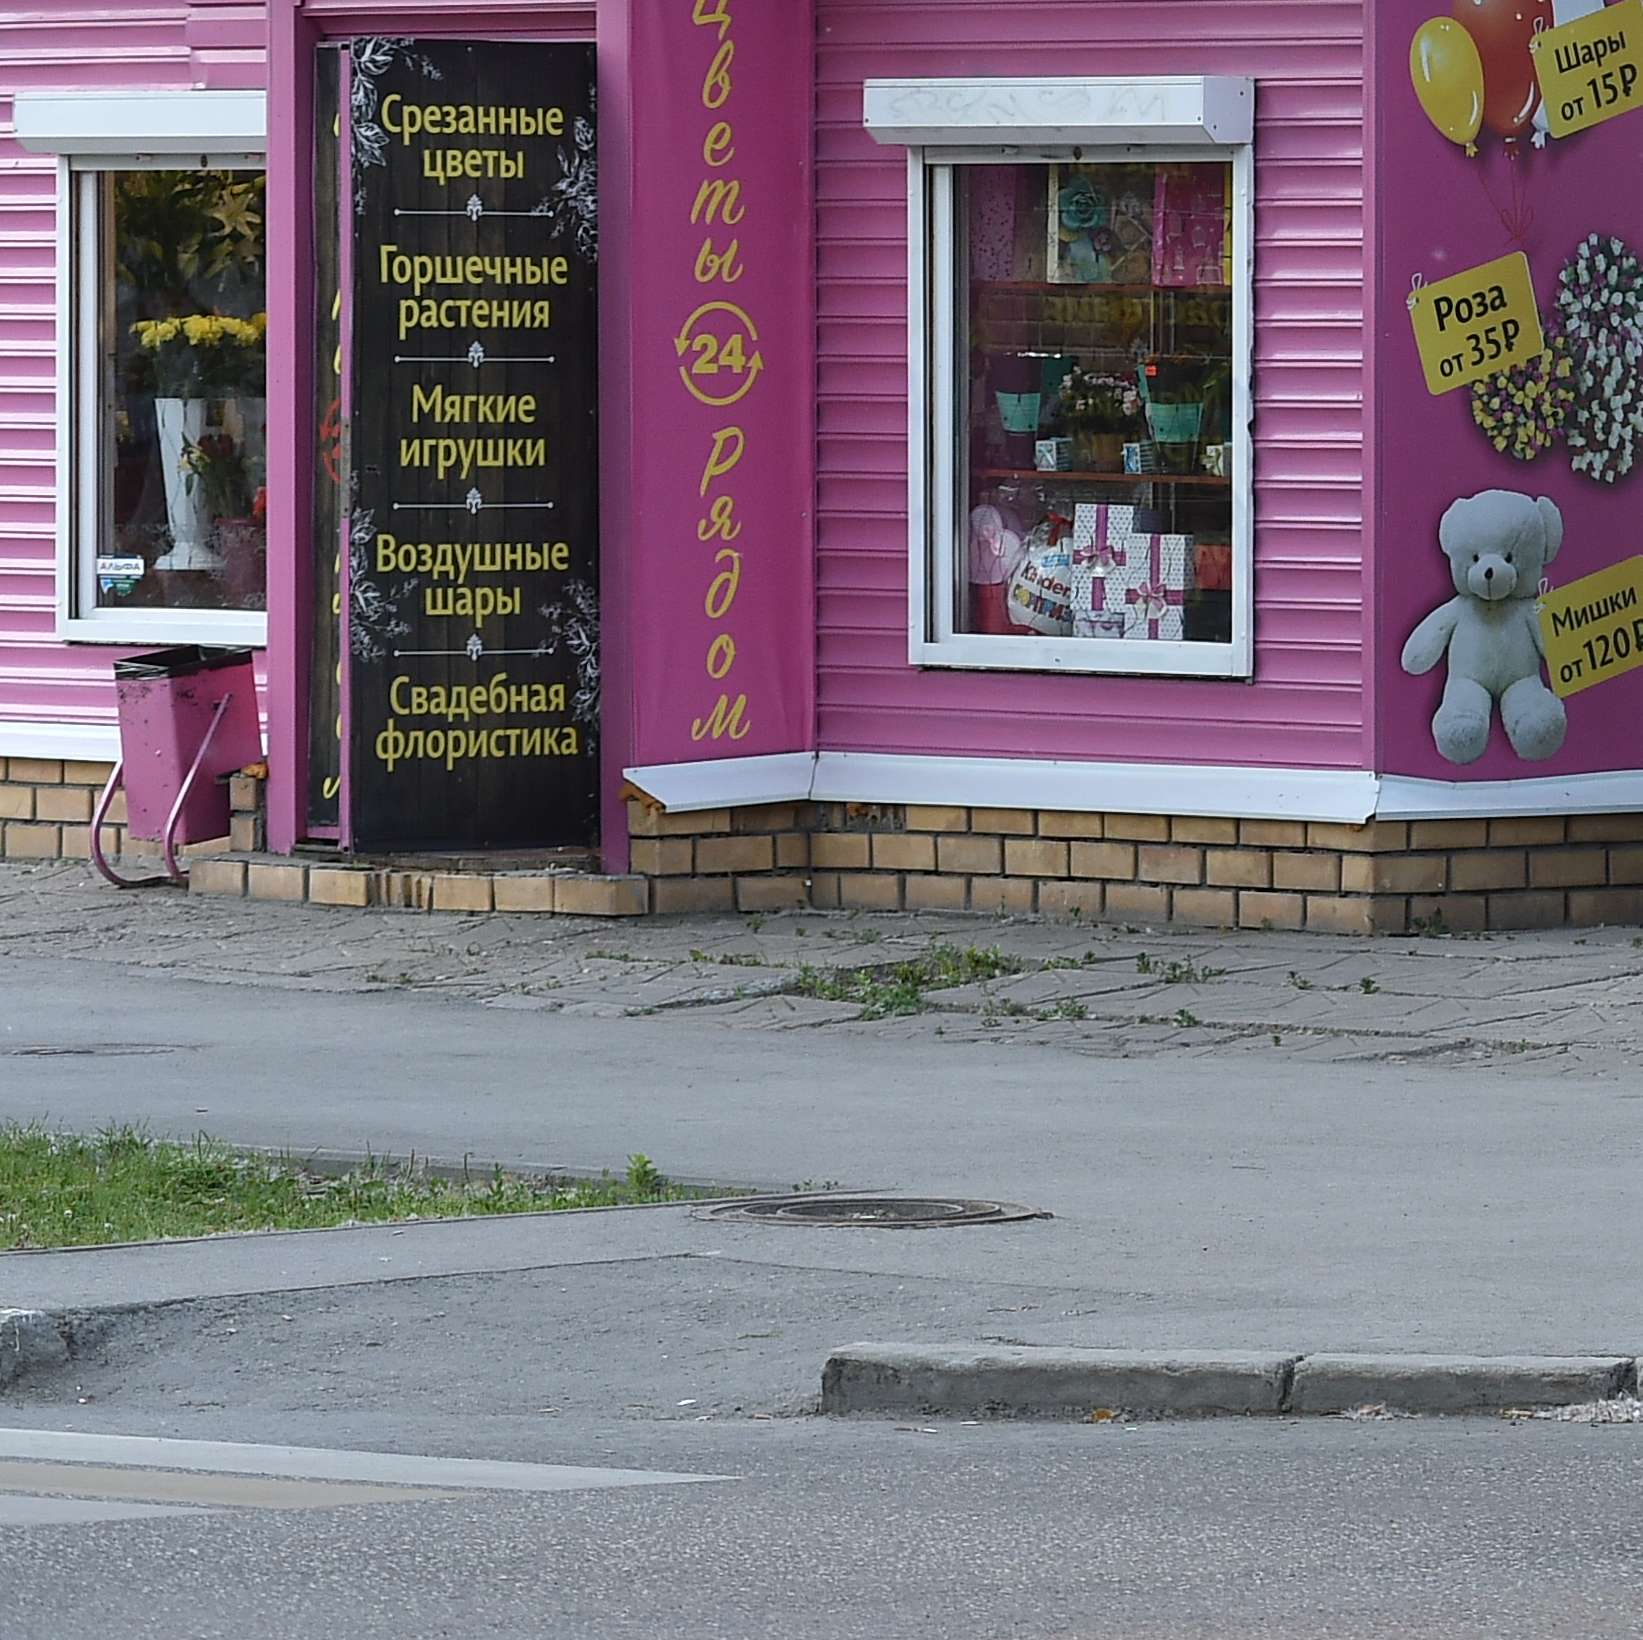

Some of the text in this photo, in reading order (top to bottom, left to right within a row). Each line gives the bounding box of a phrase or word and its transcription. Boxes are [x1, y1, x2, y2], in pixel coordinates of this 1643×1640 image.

[1553, 30, 1627, 75] Шары
[381, 94, 564, 146] Срезанные
[1560, 98, 1585, 122] от
[423, 149, 524, 186] цветы
[380, 244, 568, 296] Горшечные
[399, 298, 550, 341] растения
[1433, 284, 1508, 333] Роза
[692, 334, 746, 374] 24
[1439, 354, 1465, 379] от
[411, 384, 536, 423] Мягкие
[400, 437, 546, 480] игрушки
[376, 533, 569, 584] Воздушные
[691, 426, 752, 741] Рядом
[425, 586, 521, 628] шары
[1550, 586, 1638, 638] Мишки
[1559, 659, 1584, 684] от
[389, 672, 566, 722] Свадебная
[375, 719, 578, 772] флористика
